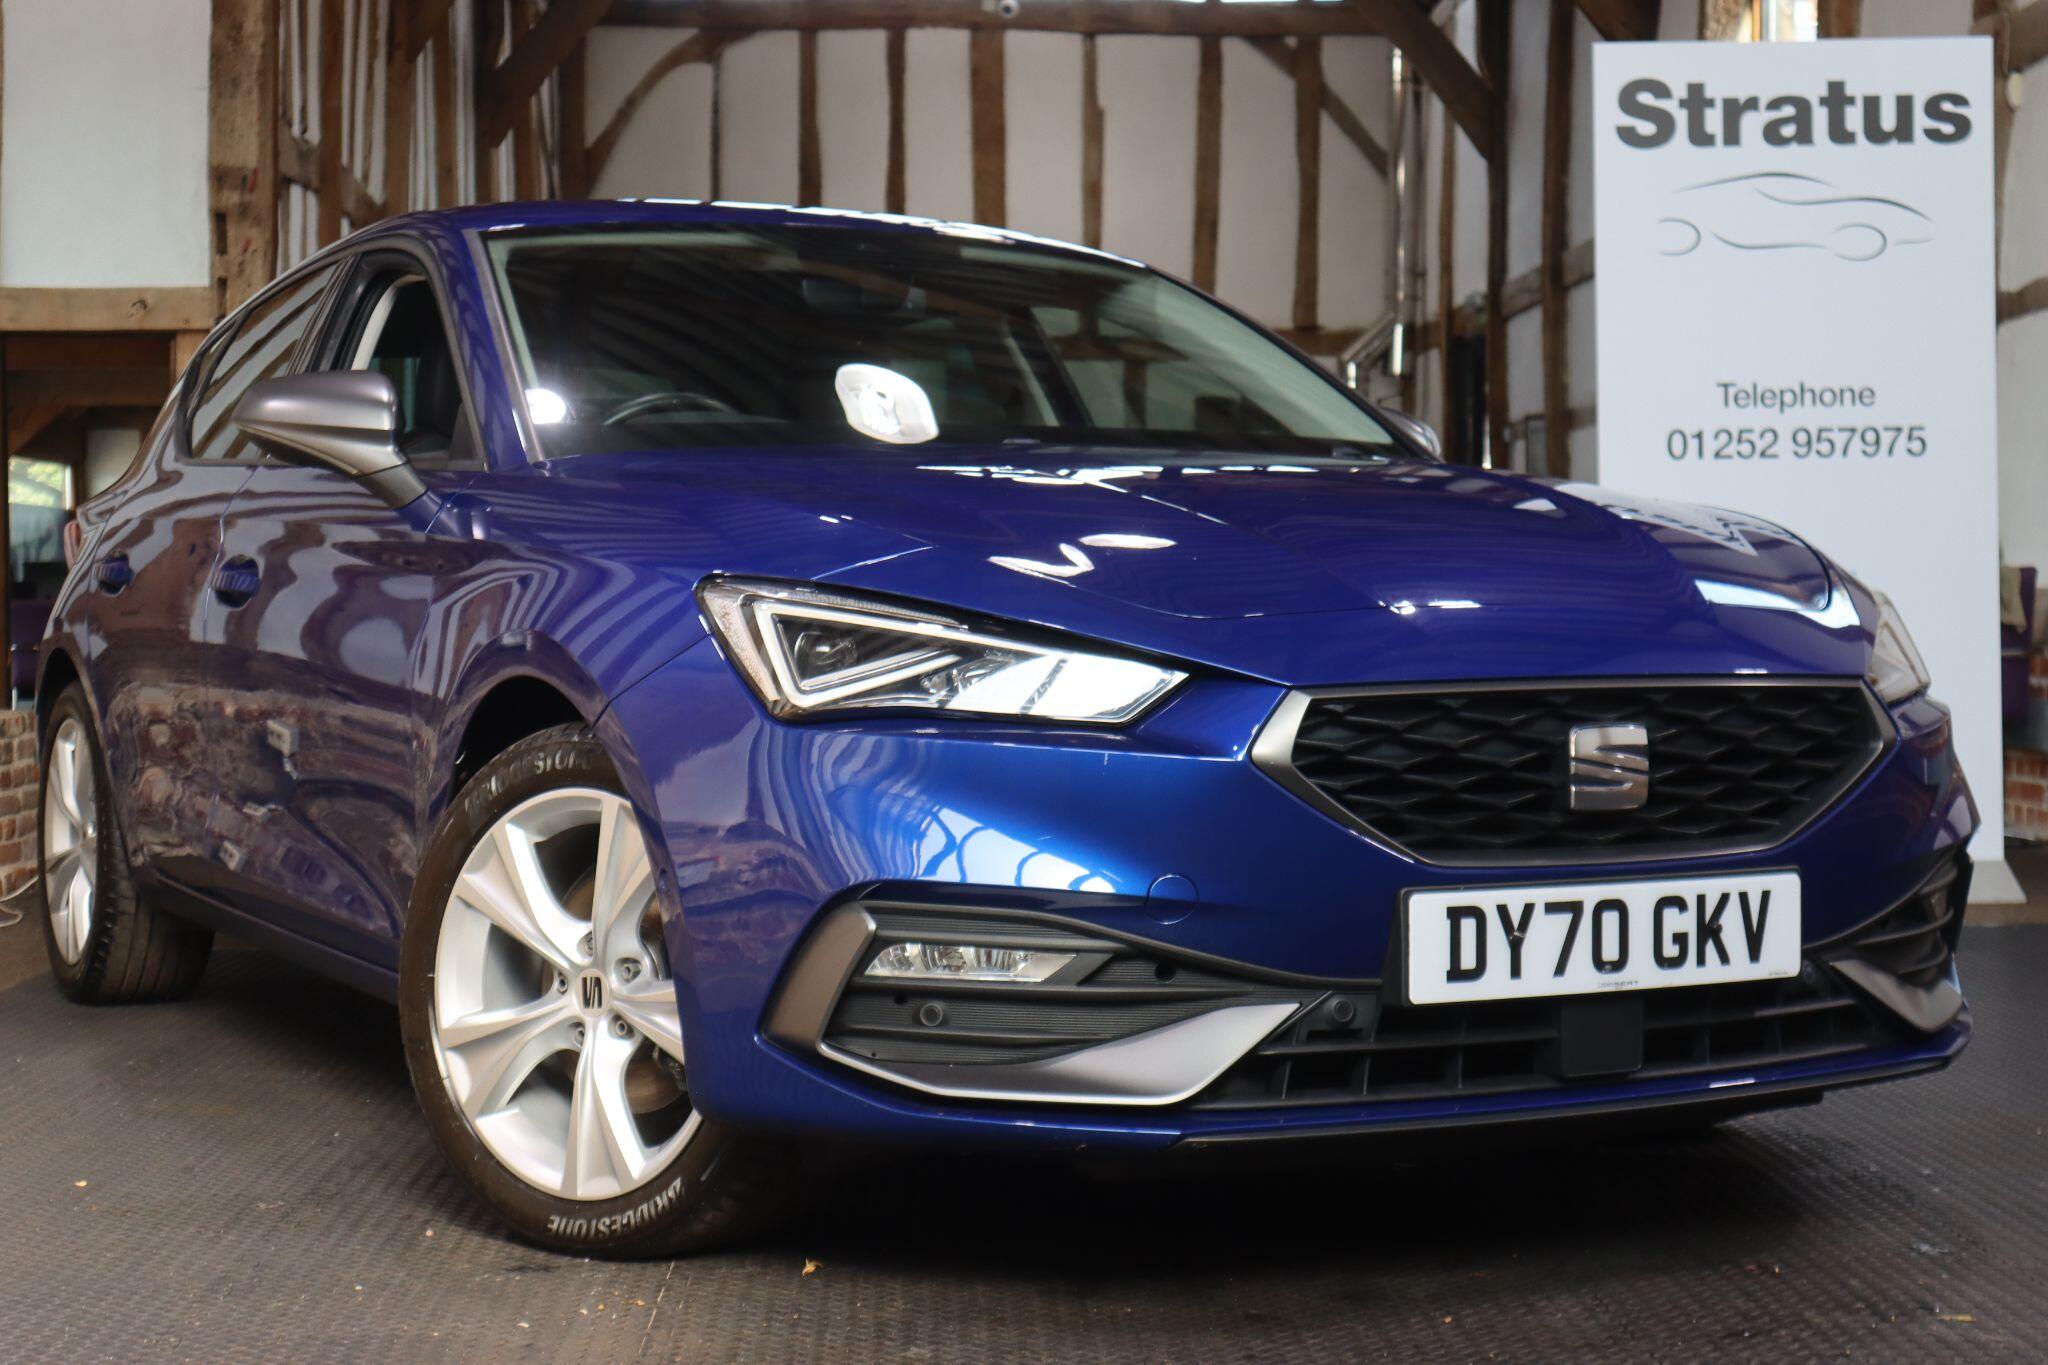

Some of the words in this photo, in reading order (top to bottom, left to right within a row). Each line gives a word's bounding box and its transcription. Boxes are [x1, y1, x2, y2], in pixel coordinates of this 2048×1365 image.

[1615, 78, 1973, 150] Stratus
[1717, 382, 1877, 414] Telephone
[1667, 428, 1780, 461] 01252
[1791, 426, 1928, 459] 957975
[1446, 898, 1630, 984] DY70
[1652, 890, 1772, 971] GKV
